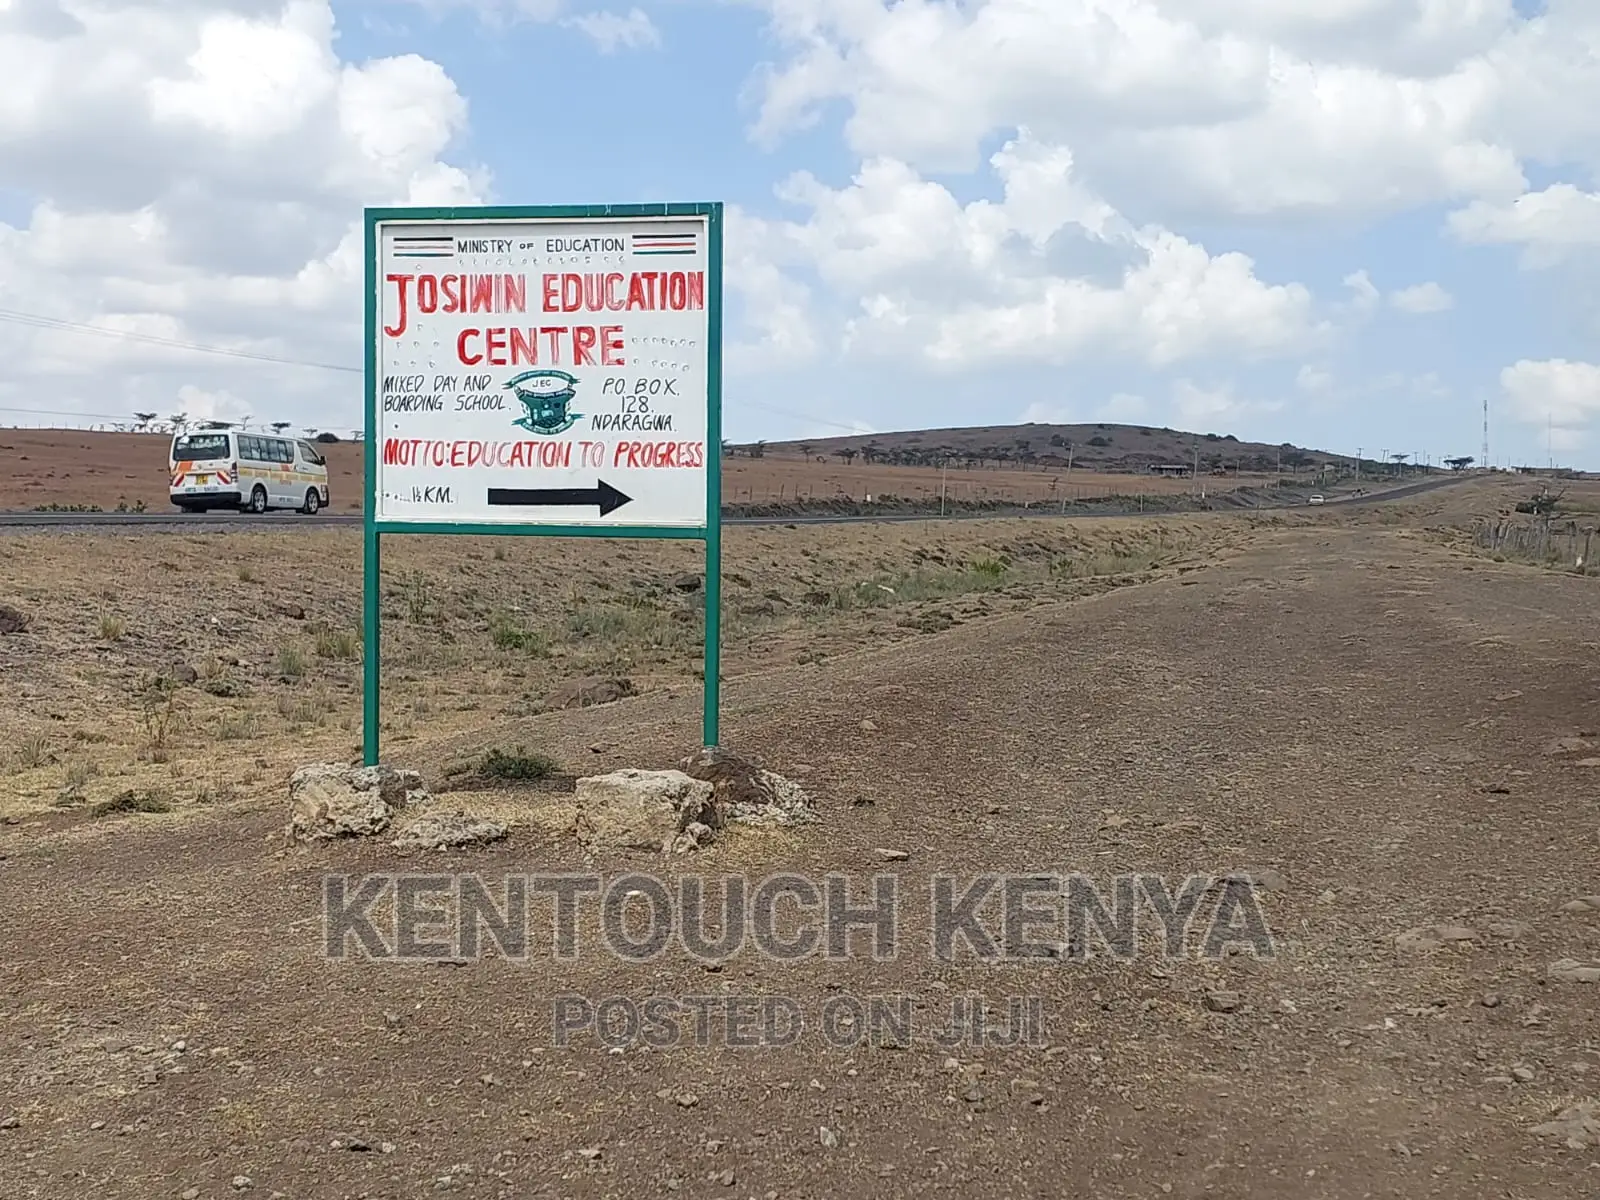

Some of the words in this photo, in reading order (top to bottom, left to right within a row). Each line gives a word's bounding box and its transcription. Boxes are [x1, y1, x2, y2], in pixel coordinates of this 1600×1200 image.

[457, 239, 513, 253] MINISTRY
[519, 242, 534, 250] OF
[546, 238, 625, 252] EDUCATION
[384, 273, 526, 337] JOSIWIN
[542, 271, 704, 312] EDUCATION
[457, 325, 625, 366] CENTRE
[383, 375, 425, 393] MIXED
[433, 375, 458, 392] DAY
[463, 374, 492, 391] AND
[384, 394, 443, 412] BOARDING
[578, 441, 605, 467] TO
[614, 441, 703, 468] PROGRESS
